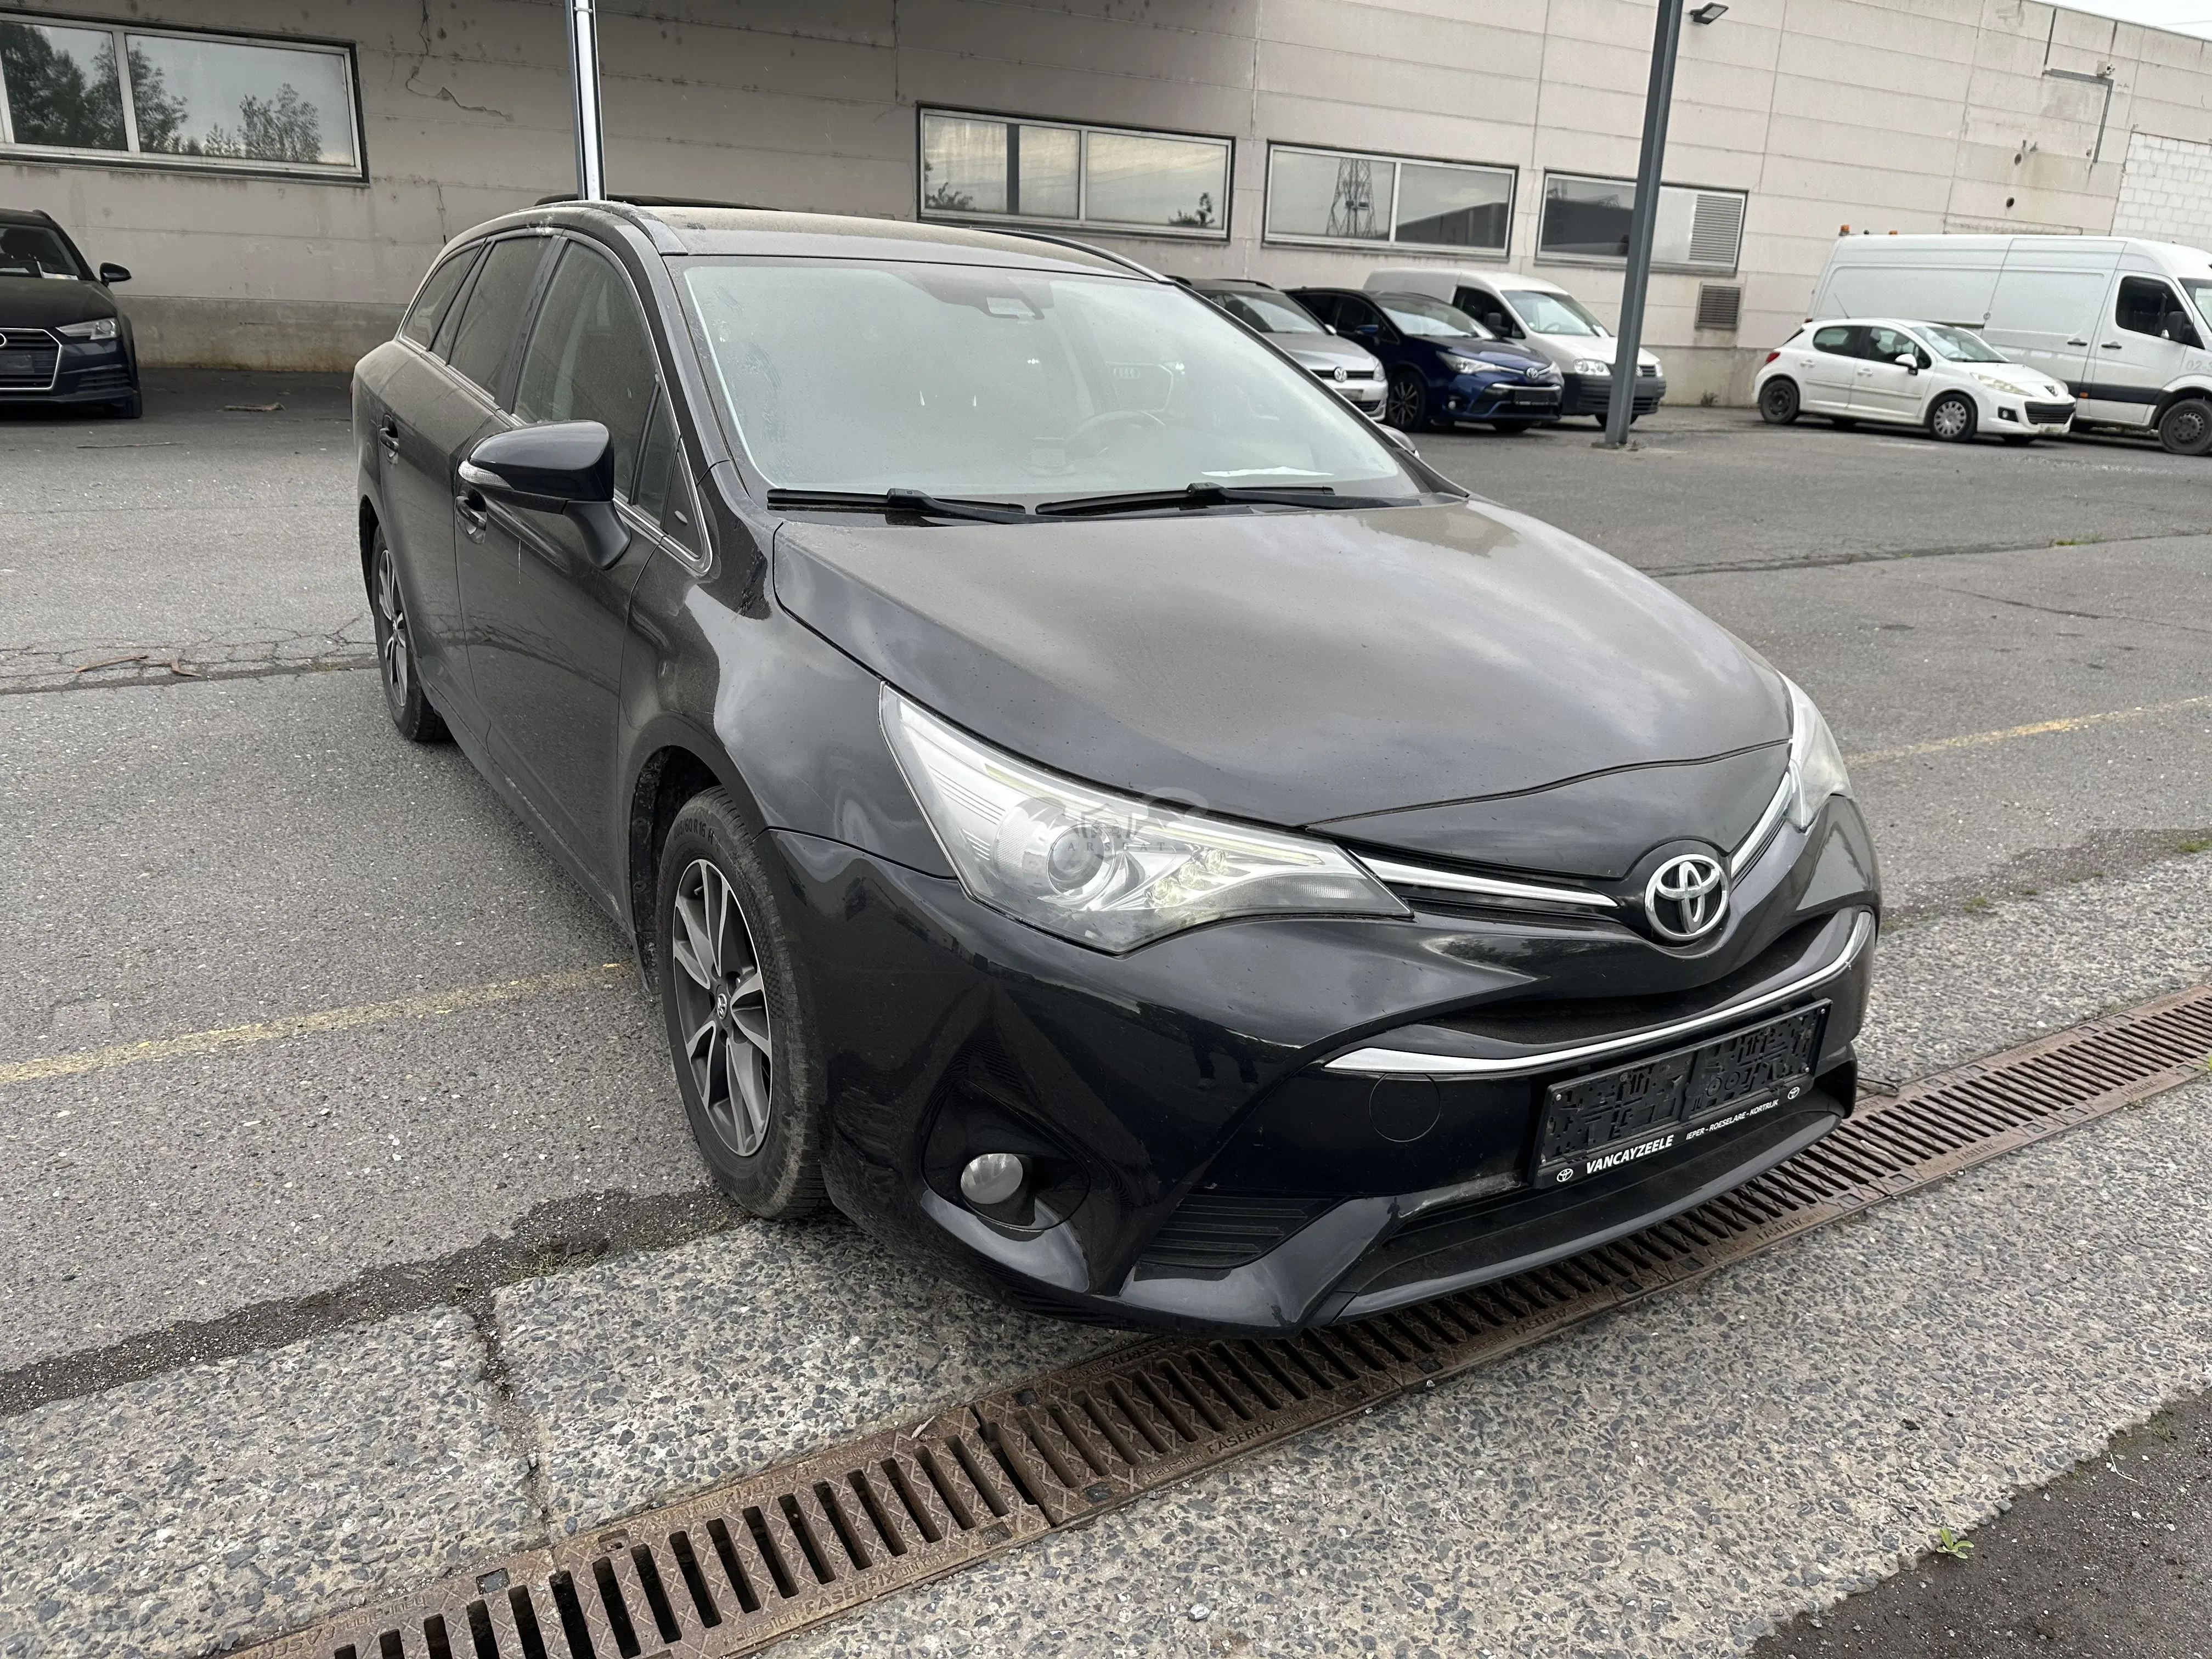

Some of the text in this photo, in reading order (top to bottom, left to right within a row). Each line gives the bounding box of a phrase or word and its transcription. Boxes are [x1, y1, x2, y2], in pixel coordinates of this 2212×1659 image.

[1586, 1134, 1674, 1174] VANCAYZEELE
[1685, 1127, 1705, 1141] IEPER
[1709, 1111, 1746, 1132] ROESELARE
[1750, 1099, 1779, 1116] KORTRIJK
[1207, 1420, 1278, 1454] FASERFIX
[804, 1569, 896, 1615] FASERFIX
